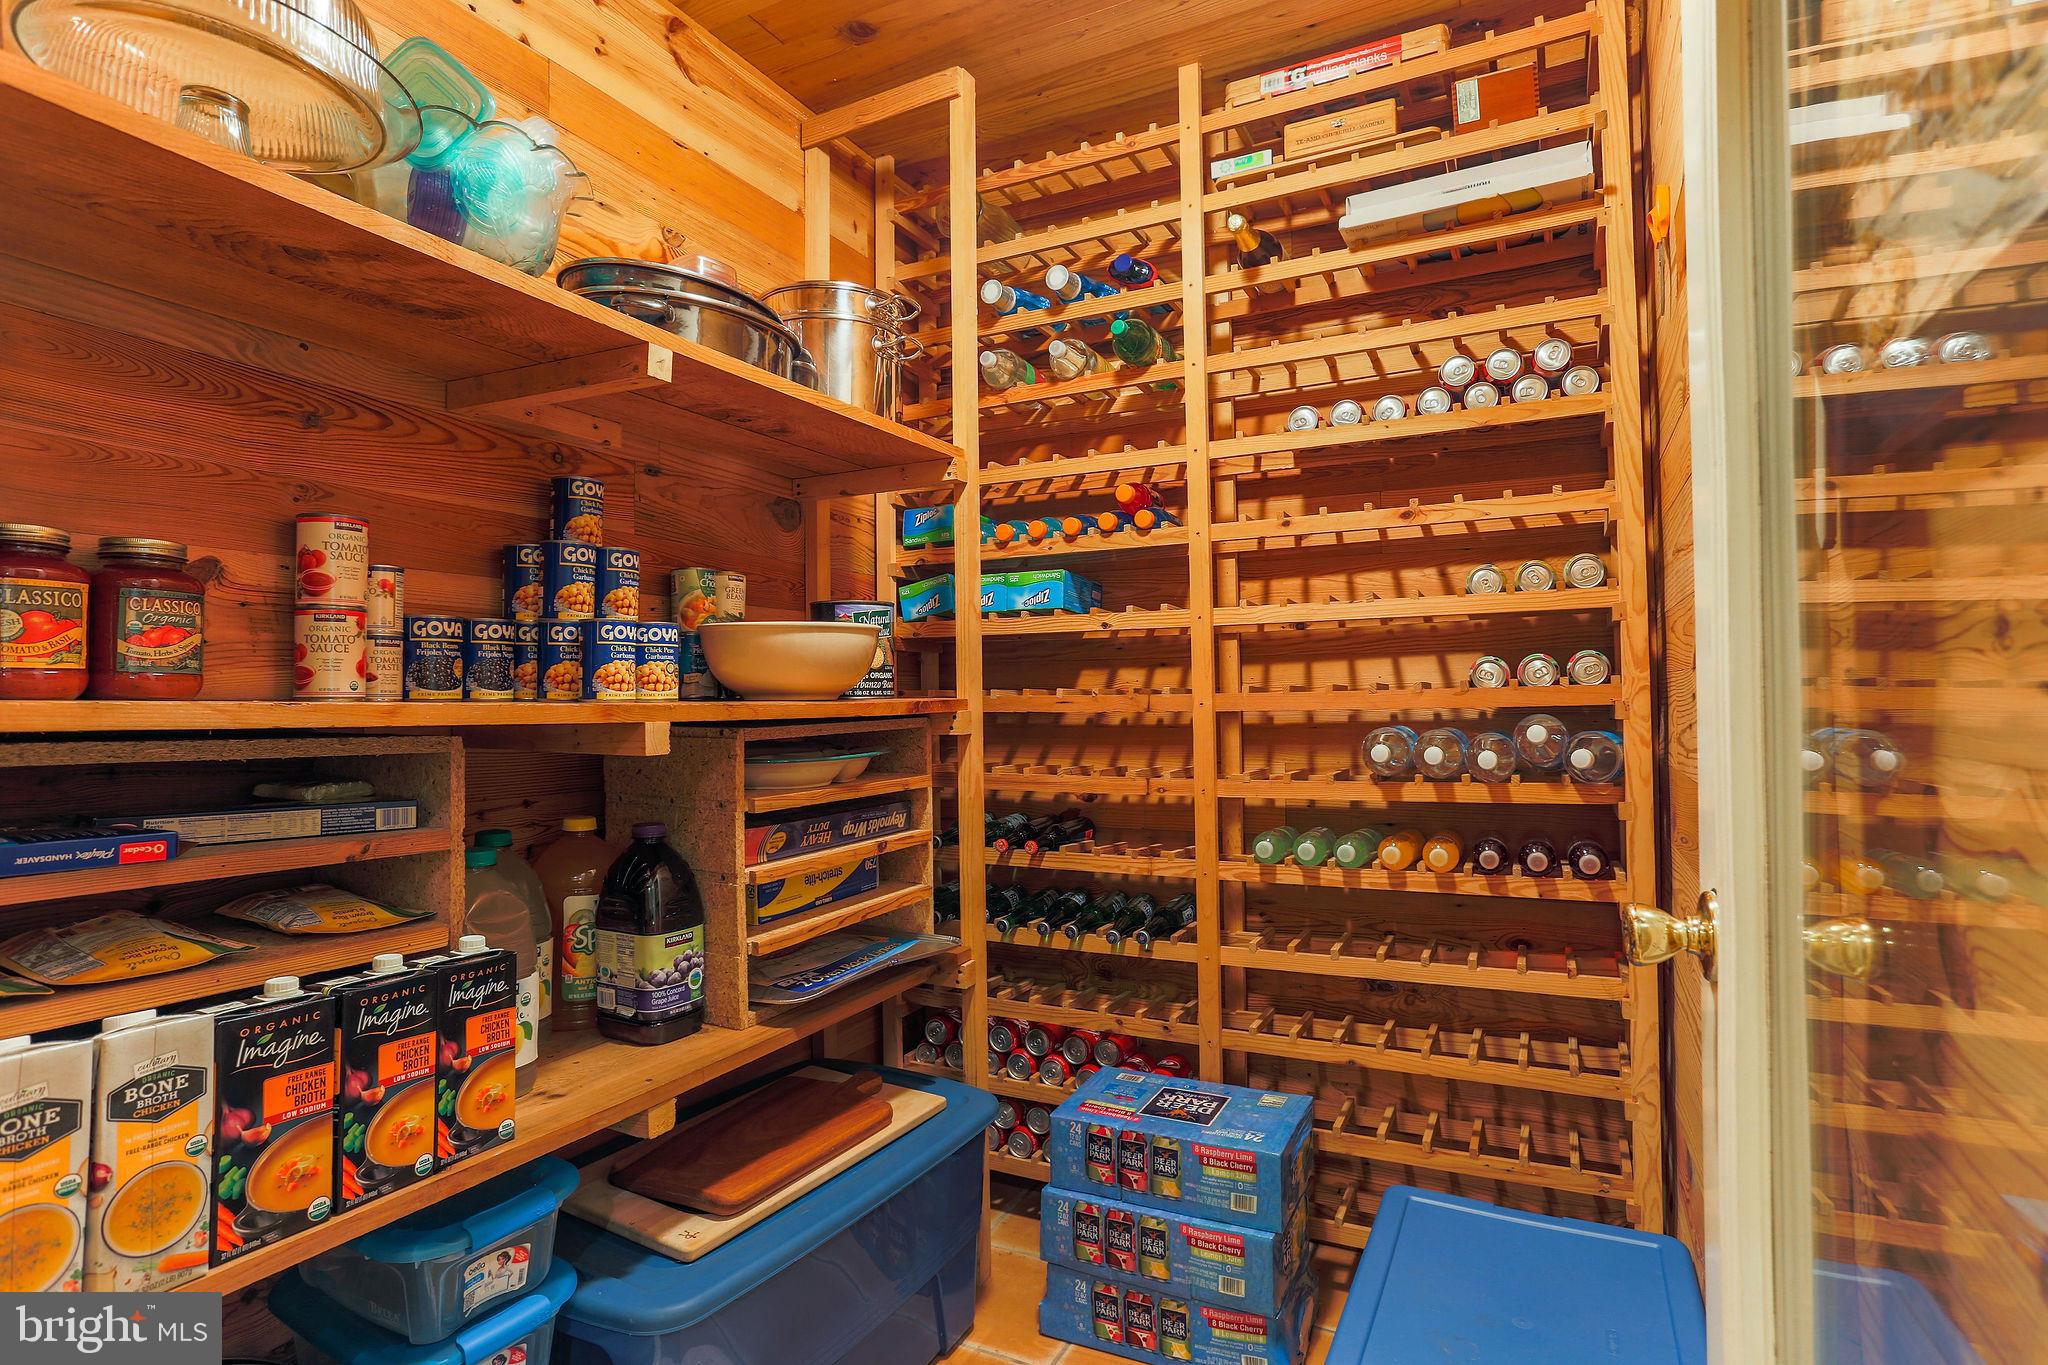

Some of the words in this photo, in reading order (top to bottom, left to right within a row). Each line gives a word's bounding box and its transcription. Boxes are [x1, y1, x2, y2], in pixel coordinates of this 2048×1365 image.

[1349, 51, 1388, 67] planks
[915, 507, 938, 526] Ziploc
[336, 521, 362, 530] KIRKLAND
[329, 533, 367, 542] ORGANIC
[904, 535, 929, 545] Sandwich
[322, 541, 368, 555] TOMATO
[330, 551, 365, 563] SAUCE
[610, 552, 640, 568] GOY
[1032, 570, 1061, 580] Sandwich
[1025, 588, 1050, 608] Ziploc
[129, 596, 200, 615] CLASSICO
[917, 594, 941, 617] Ziploc
[142, 613, 193, 625] Organic
[308, 625, 352, 633] ORGANIC
[412, 620, 463, 637] GOYA
[637, 627, 678, 643] GOYA
[0, 644, 40, 654] OMATO
[48, 634, 74, 649] BASIL
[304, 634, 356, 645] TOMATO
[310, 643, 350, 654] SAUCE
[416, 648, 442, 658] Frijoles
[478, 650, 501, 659] Frijoles
[145, 819, 174, 827] Nutrition
[806, 821, 831, 834] DUTY
[868, 811, 907, 831] Reynolds
[842, 821, 867, 837] Wrap
[800, 831, 832, 848] HEAVY
[76, 847, 114, 860] Playtex
[123, 843, 164, 855] O-Cedar
[16, 853, 72, 865] HANDSAVER
[804, 867, 843, 887] stretch-tite
[666, 932, 693, 944] KIRKLAND
[144, 945, 179, 956] Brown
[125, 952, 181, 970] Organic
[843, 954, 873, 972] Rack
[450, 963, 506, 983] ORGANIC
[360, 984, 426, 1007] ORGANIC
[449, 978, 507, 1010] Imagine
[651, 989, 666, 999] 100%
[666, 985, 686, 995] Concord
[651, 997, 667, 1006] Grape
[668, 994, 680, 1003] Juice
[356, 1000, 427, 1036] Imagine
[482, 1014, 493, 1023] FREE
[494, 1011, 511, 1020] RANGE
[240, 1011, 321, 1038] ORGANIC
[480, 1018, 510, 1035] CHICKEN
[397, 1041, 410, 1050] FREE
[412, 1036, 430, 1048] RANGE
[486, 1029, 511, 1043] BROTH
[235, 1029, 322, 1069] Imagine
[396, 1045, 430, 1062] CHICKEN
[478, 1043, 490, 1053] LOW
[490, 1040, 511, 1050] SODIUM
[403, 1056, 430, 1072] BROTH
[142, 1070, 175, 1083] ORGANIC
[288, 1073, 303, 1084] FREE
[305, 1068, 326, 1079] RANGE
[393, 1072, 406, 1083] LOW
[407, 1067, 430, 1079] SODIUM
[124, 1073, 190, 1104] BONE
[285, 1077, 326, 1097] CHICKEN
[136, 1090, 178, 1109] BROTH
[294, 1089, 326, 1107] BROTH
[1162, 1092, 1218, 1107] PARK
[4, 1102, 44, 1119] ORGANIC
[132, 1099, 181, 1118] CHICKEN
[282, 1108, 298, 1120] LOW
[299, 1102, 326, 1115] SODIUM
[1107, 1108, 1126, 1116] Black
[1155, 1100, 1215, 1115] DEER
[0, 1106, 61, 1135] ONE
[1070, 1121, 1082, 1133] 24
[126, 1140, 162, 1156] FREE-RANGE
[164, 1132, 190, 1146] CHICKEN
[190, 1138, 204, 1147] USDA
[1244, 1132, 1265, 1143] 24
[1089, 1143, 1111, 1154] DEER
[1089, 1149, 1111, 1161] PARK
[1122, 1149, 1143, 1160] DEER
[1200, 1146, 1234, 1160] Raspberry
[1236, 1152, 1253, 1161] Lime
[418, 1157, 431, 1166] USDA
[1121, 1156, 1144, 1168] PARK
[1154, 1156, 1177, 1167] DEER
[1209, 1158, 1228, 1167] Black
[1229, 1162, 1253, 1172] Cherry
[1154, 1163, 1177, 1175] PARK
[312, 1200, 327, 1210] USDA
[1057, 1200, 1070, 1212] 24
[1077, 1221, 1098, 1233] DEER
[1077, 1228, 1098, 1240] PARK
[1109, 1229, 1131, 1241] DEER
[1142, 1236, 1164, 1248] DEER
[1188, 1227, 1222, 1242] Raspberry
[1223, 1235, 1241, 1245] Lime
[1109, 1236, 1131, 1249] PARK
[1142, 1244, 1165, 1255] PARK
[1197, 1240, 1217, 1250] Black
[1218, 1243, 1241, 1256] Cherry
[1075, 1279, 1086, 1293] 24
[1096, 1300, 1117, 1312] DEER
[1096, 1306, 1118, 1319] PARK
[1128, 1309, 1151, 1320] DEER
[1209, 1309, 1244, 1324] Raspberry
[1246, 1315, 1263, 1324] Lime
[1128, 1316, 1151, 1328] PARK
[1162, 1318, 1185, 1329] DEER
[1218, 1320, 1238, 1330] Black
[1240, 1324, 1264, 1335] Cherry
[1162, 1325, 1186, 1337] PARK
